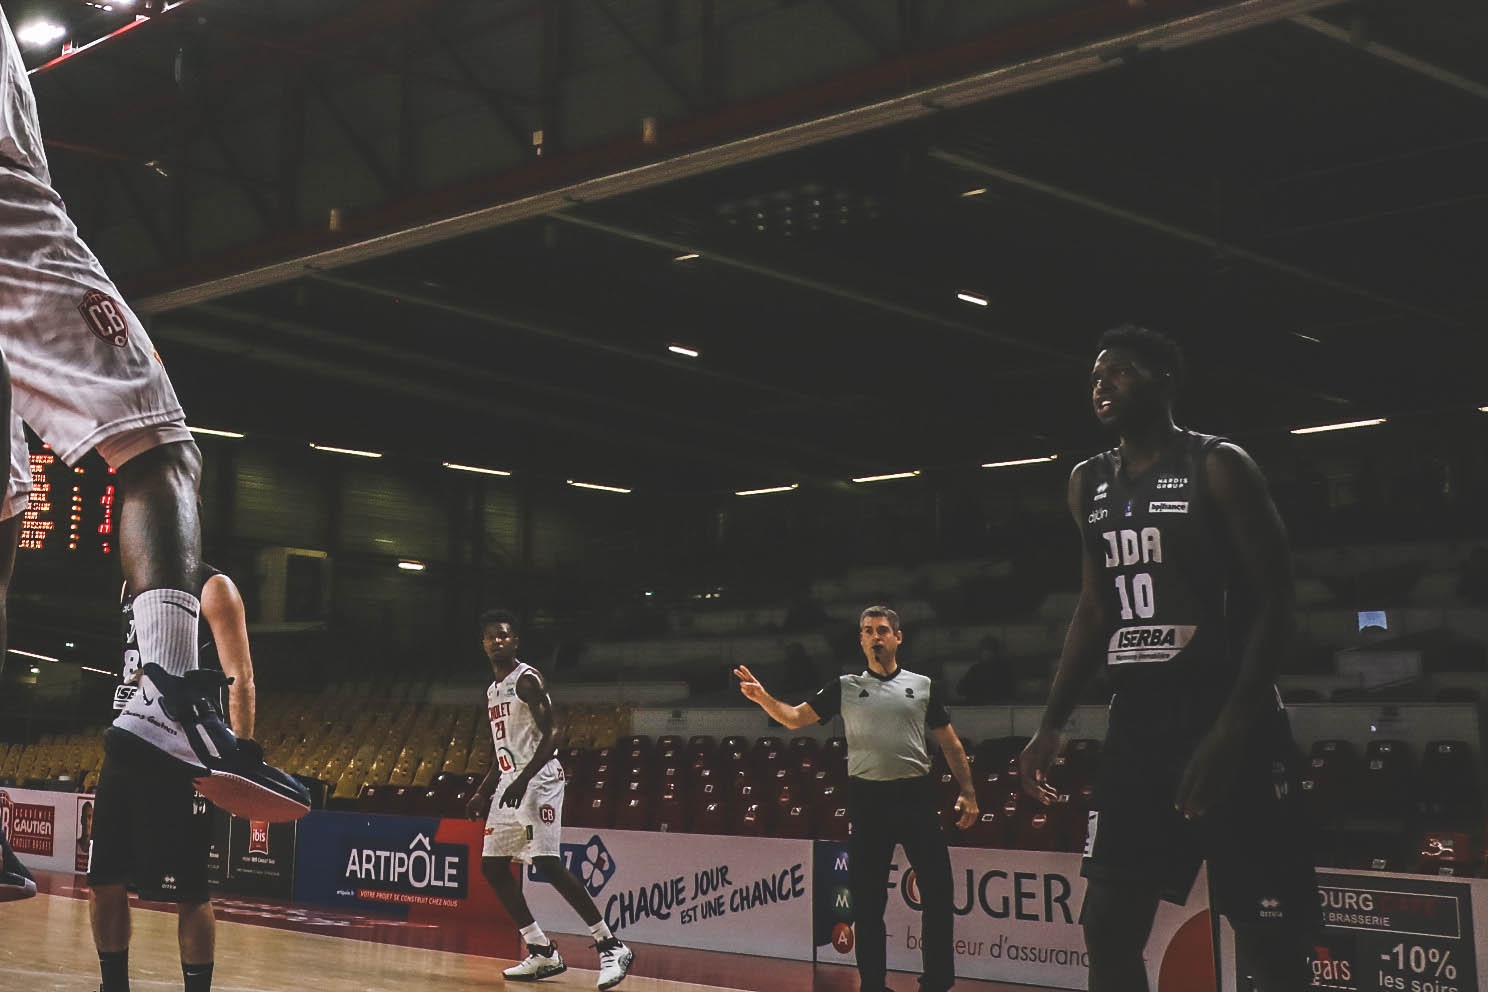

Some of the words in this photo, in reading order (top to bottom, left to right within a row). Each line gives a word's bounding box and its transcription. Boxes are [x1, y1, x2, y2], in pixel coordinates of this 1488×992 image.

[1103, 527, 1162, 568] JDA
[1115, 573, 1155, 620] 10
[1118, 629, 1175, 648] ISERBA
[123, 649, 140, 685] 8
[541, 809, 554, 822] CB
[252, 828, 266, 842] ibis
[345, 833, 459, 888] ARTIPÔLE
[360, 890, 378, 899] VOTRE
[401, 894, 428, 905] CONSTRUIT
[429, 897, 442, 906] CHEZ
[443, 898, 458, 907] NOUS
[604, 876, 686, 932] CHAQUE
[691, 865, 733, 900] JOUR
[680, 904, 698, 925] EST
[701, 894, 725, 919] UNE
[730, 863, 805, 913] CHANCE
[1329, 912, 1391, 927] BRASSERIE
[1380, 943, 1457, 981] -10%
[1378, 970, 1405, 990] les
[1411, 980, 1460, 992] soirs
